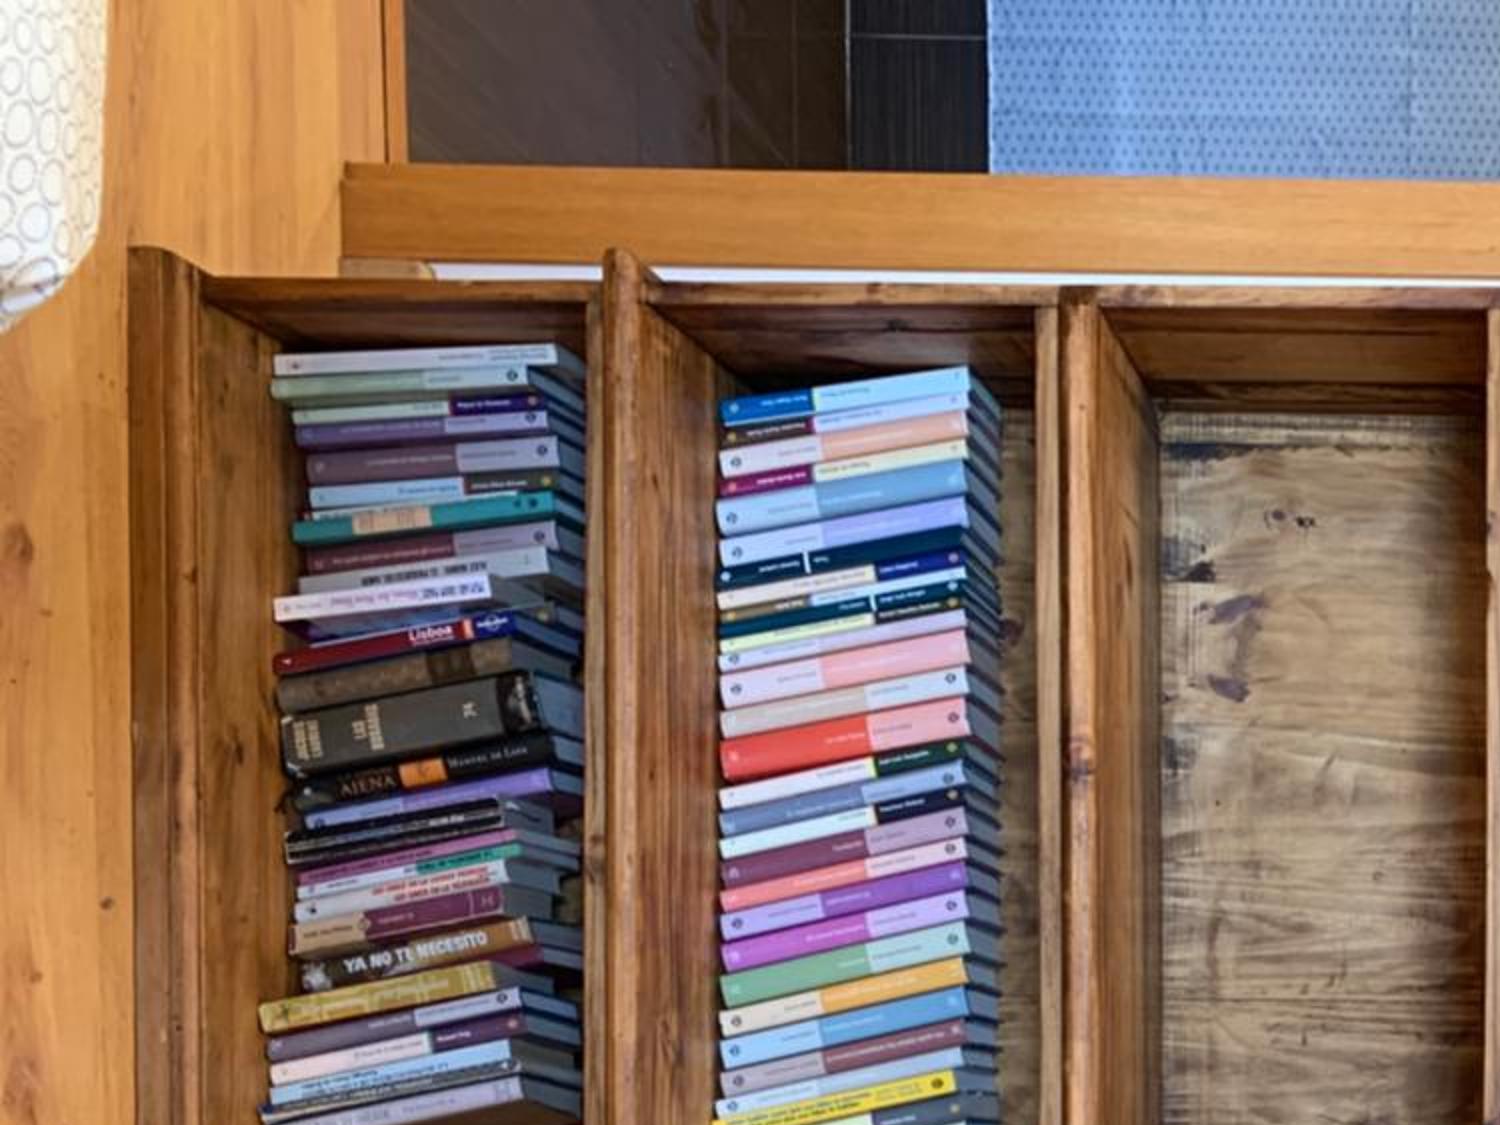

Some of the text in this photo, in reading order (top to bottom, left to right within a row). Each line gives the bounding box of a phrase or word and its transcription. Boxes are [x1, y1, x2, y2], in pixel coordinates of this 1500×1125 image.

[409, 624, 453, 642] Lisboa
[343, 931, 488, 973] YA NO TE NECESITO
